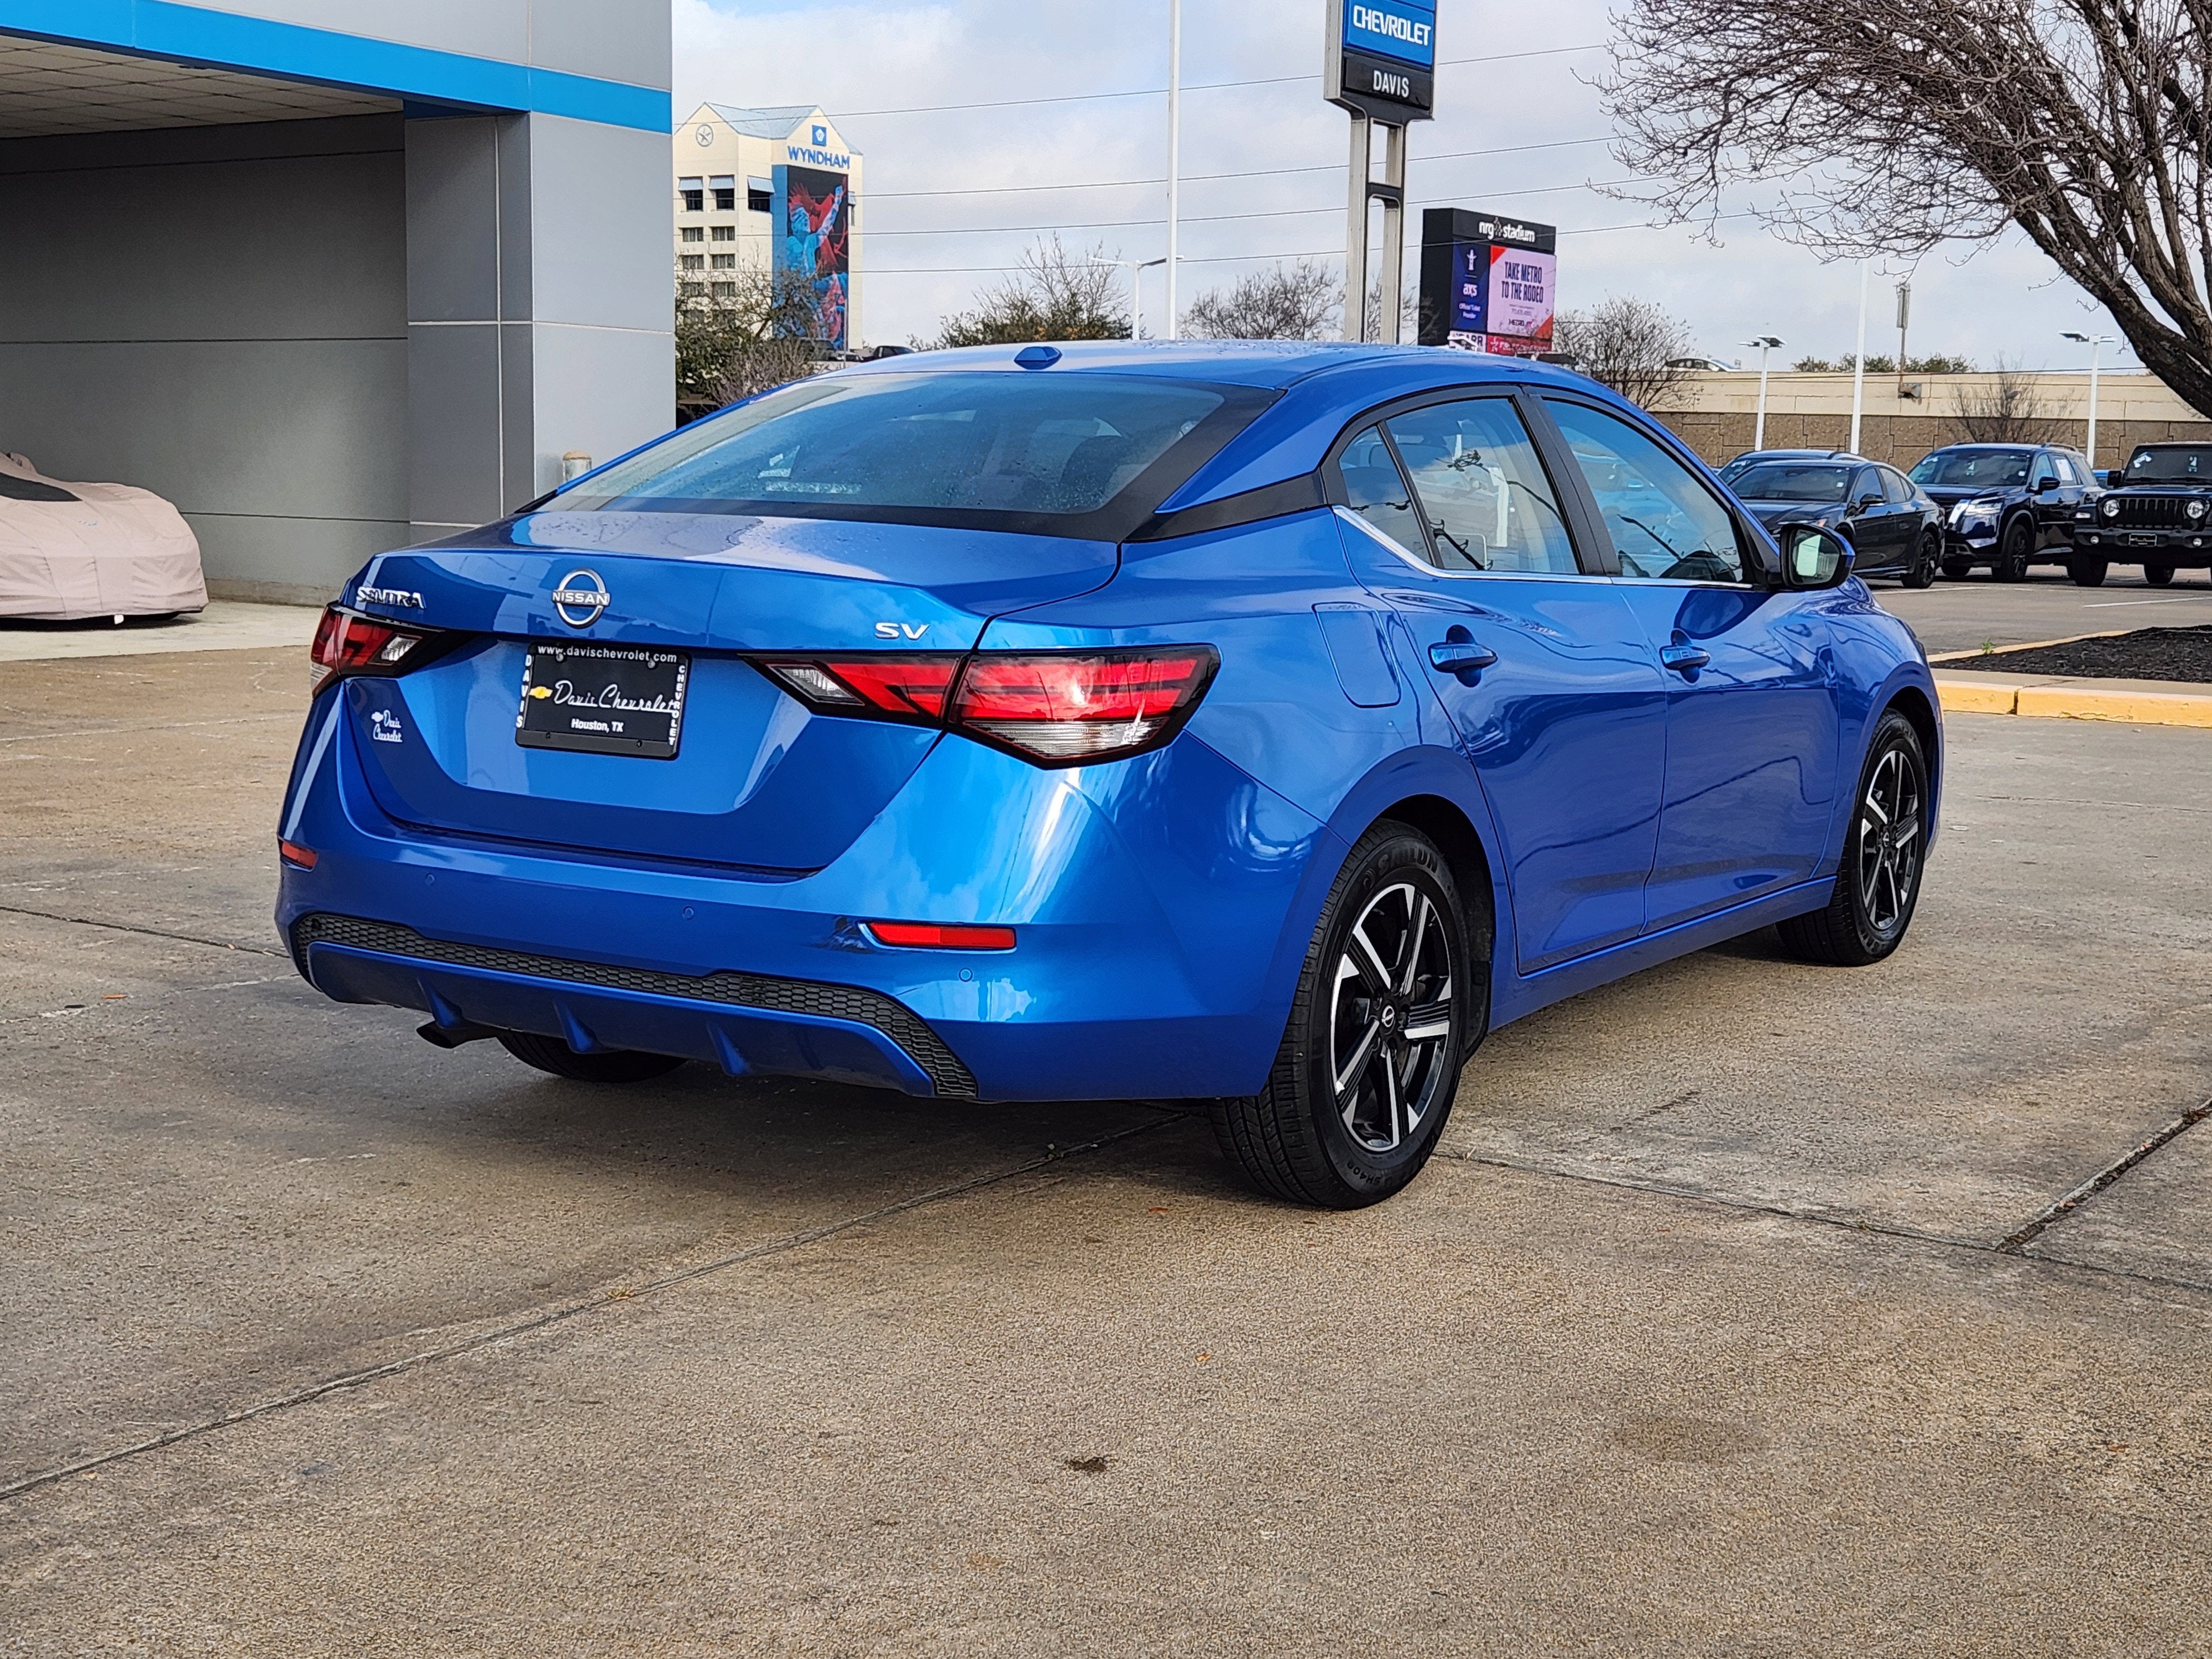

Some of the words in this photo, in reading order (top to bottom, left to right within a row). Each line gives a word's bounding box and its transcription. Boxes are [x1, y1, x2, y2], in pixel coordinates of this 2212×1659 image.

[1353, 5, 1431, 46] CHEVROLET
[1373, 70, 1410, 98] DAVIS
[787, 145, 851, 169] WYNDHAM
[1479, 221, 1494, 239] nrg
[1503, 223, 1536, 242] stadium
[1504, 261, 1520, 280] TAKE
[1521, 263, 1542, 284] METRO
[1501, 280, 1510, 299] TO
[1511, 281, 1522, 300] THE
[1523, 284, 1544, 304] RODEO
[356, 586, 424, 609] SENTRA
[552, 592, 608, 606] NISSAN
[875, 622, 930, 640] SV
[515, 654, 532, 728] DAVIS
[554, 680, 598, 707] Davis
[599, 684, 676, 713] Chevrolet
[668, 665, 686, 746] CHEVROLET
[571, 718, 609, 734] Houston,
[611, 721, 624, 733] TX
